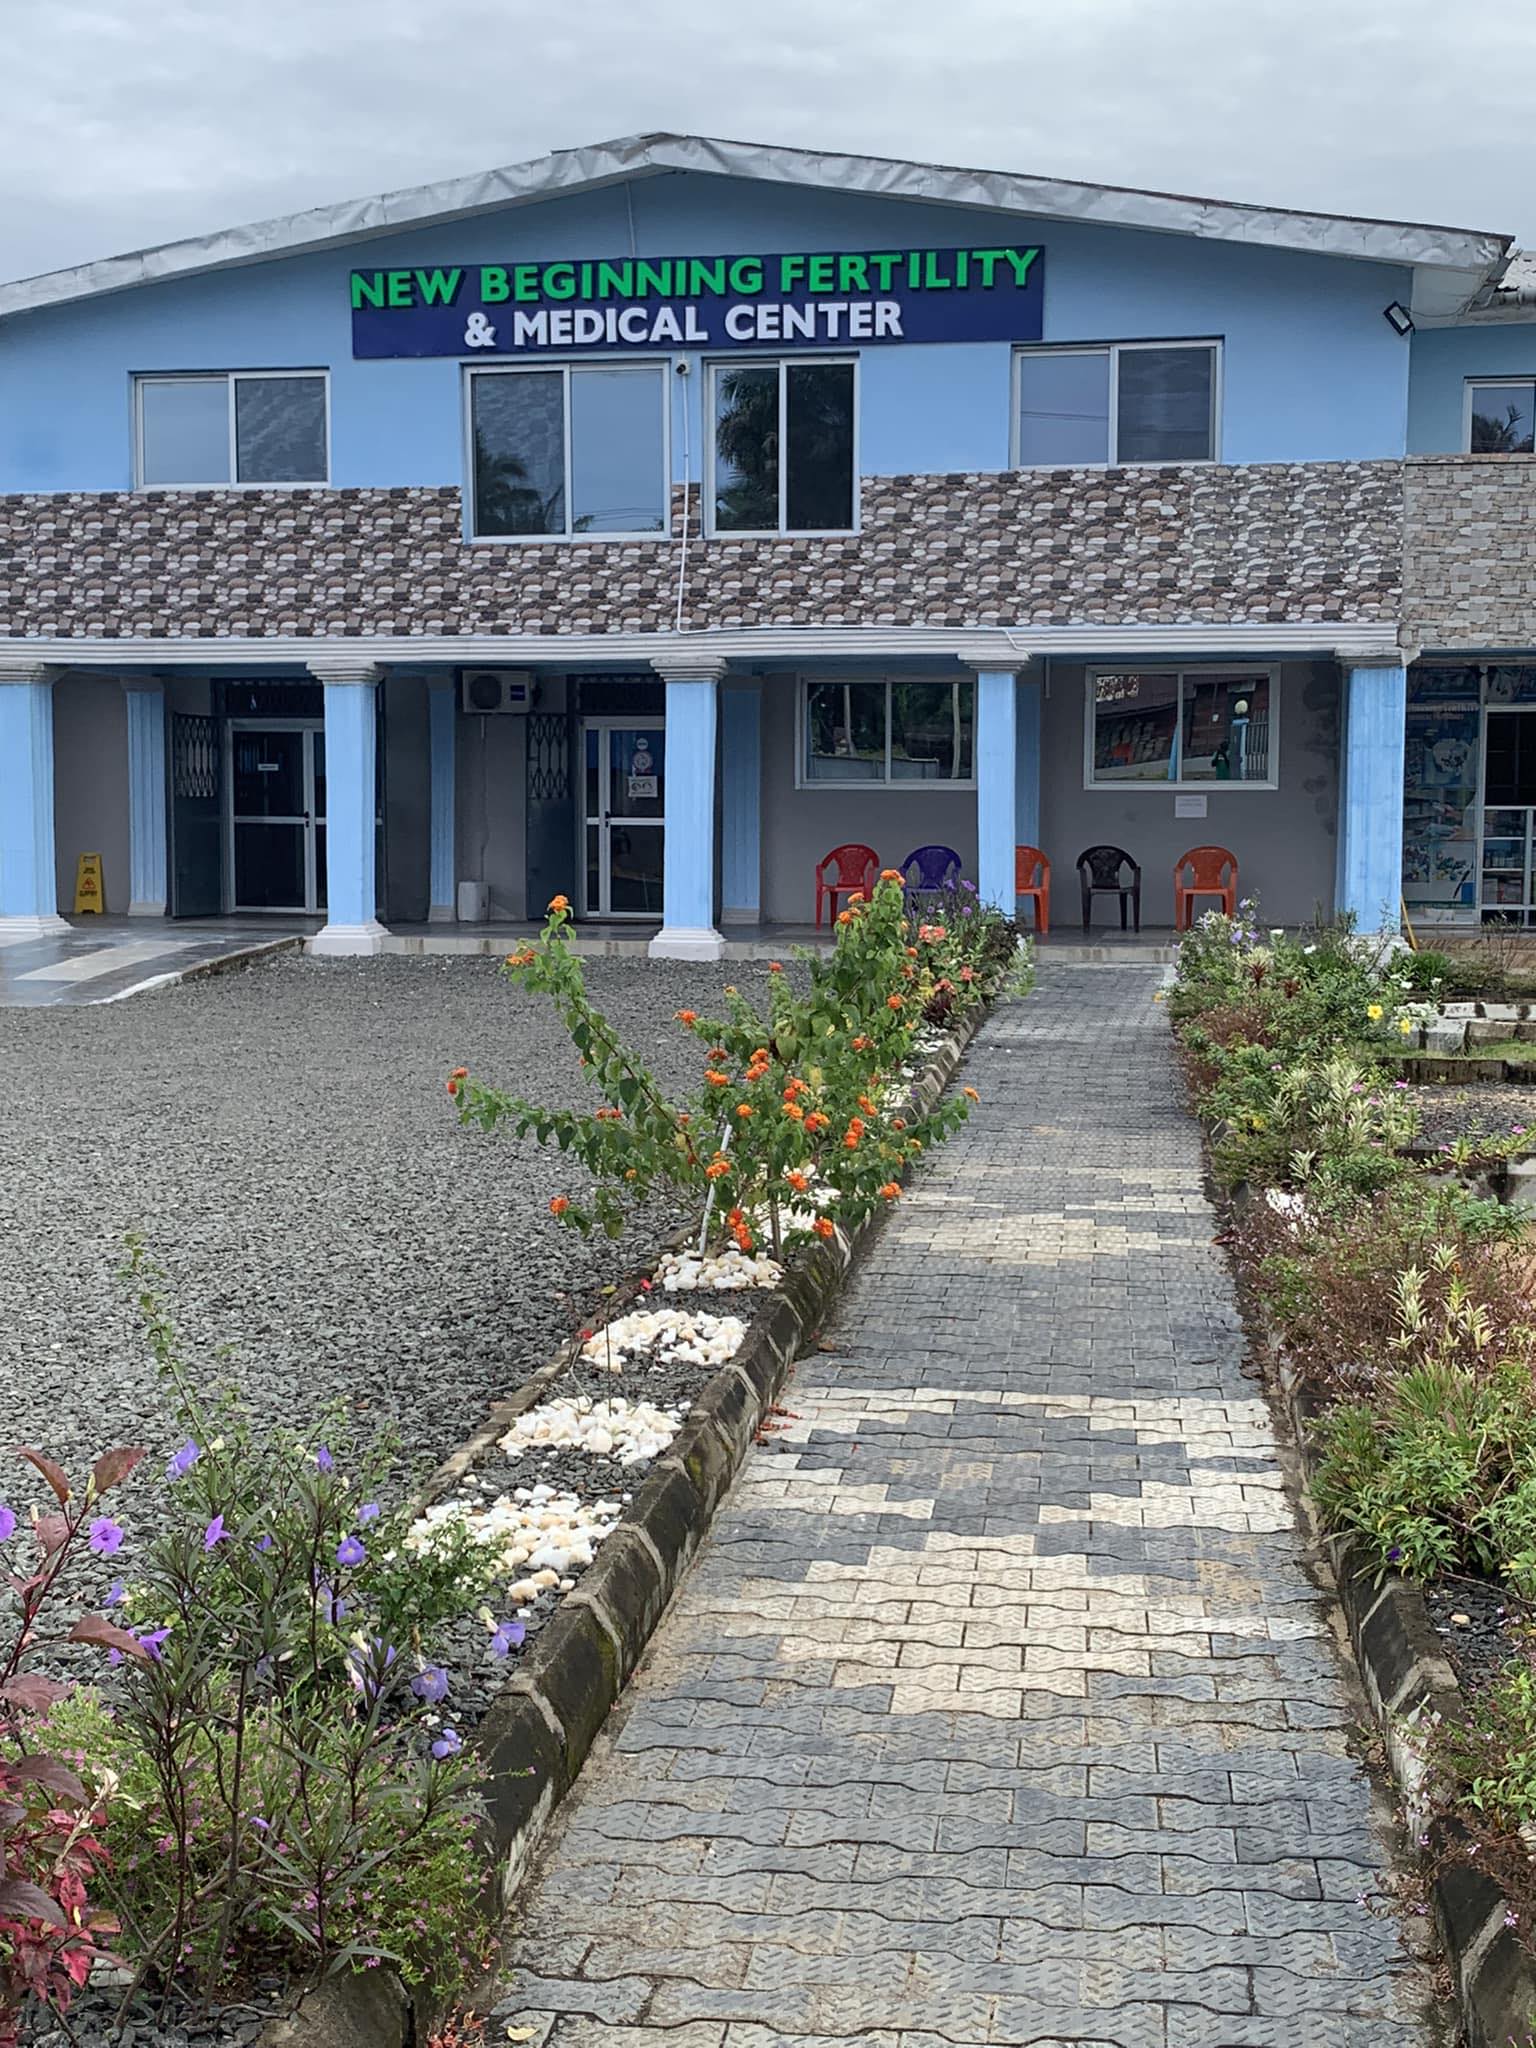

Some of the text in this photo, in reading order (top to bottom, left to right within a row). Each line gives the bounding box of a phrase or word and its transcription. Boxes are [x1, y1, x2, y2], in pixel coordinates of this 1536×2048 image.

[351, 249, 1039, 308] NEW BEGINNING FERTILITY
[464, 301, 904, 347] & MEDICAL CENTER
